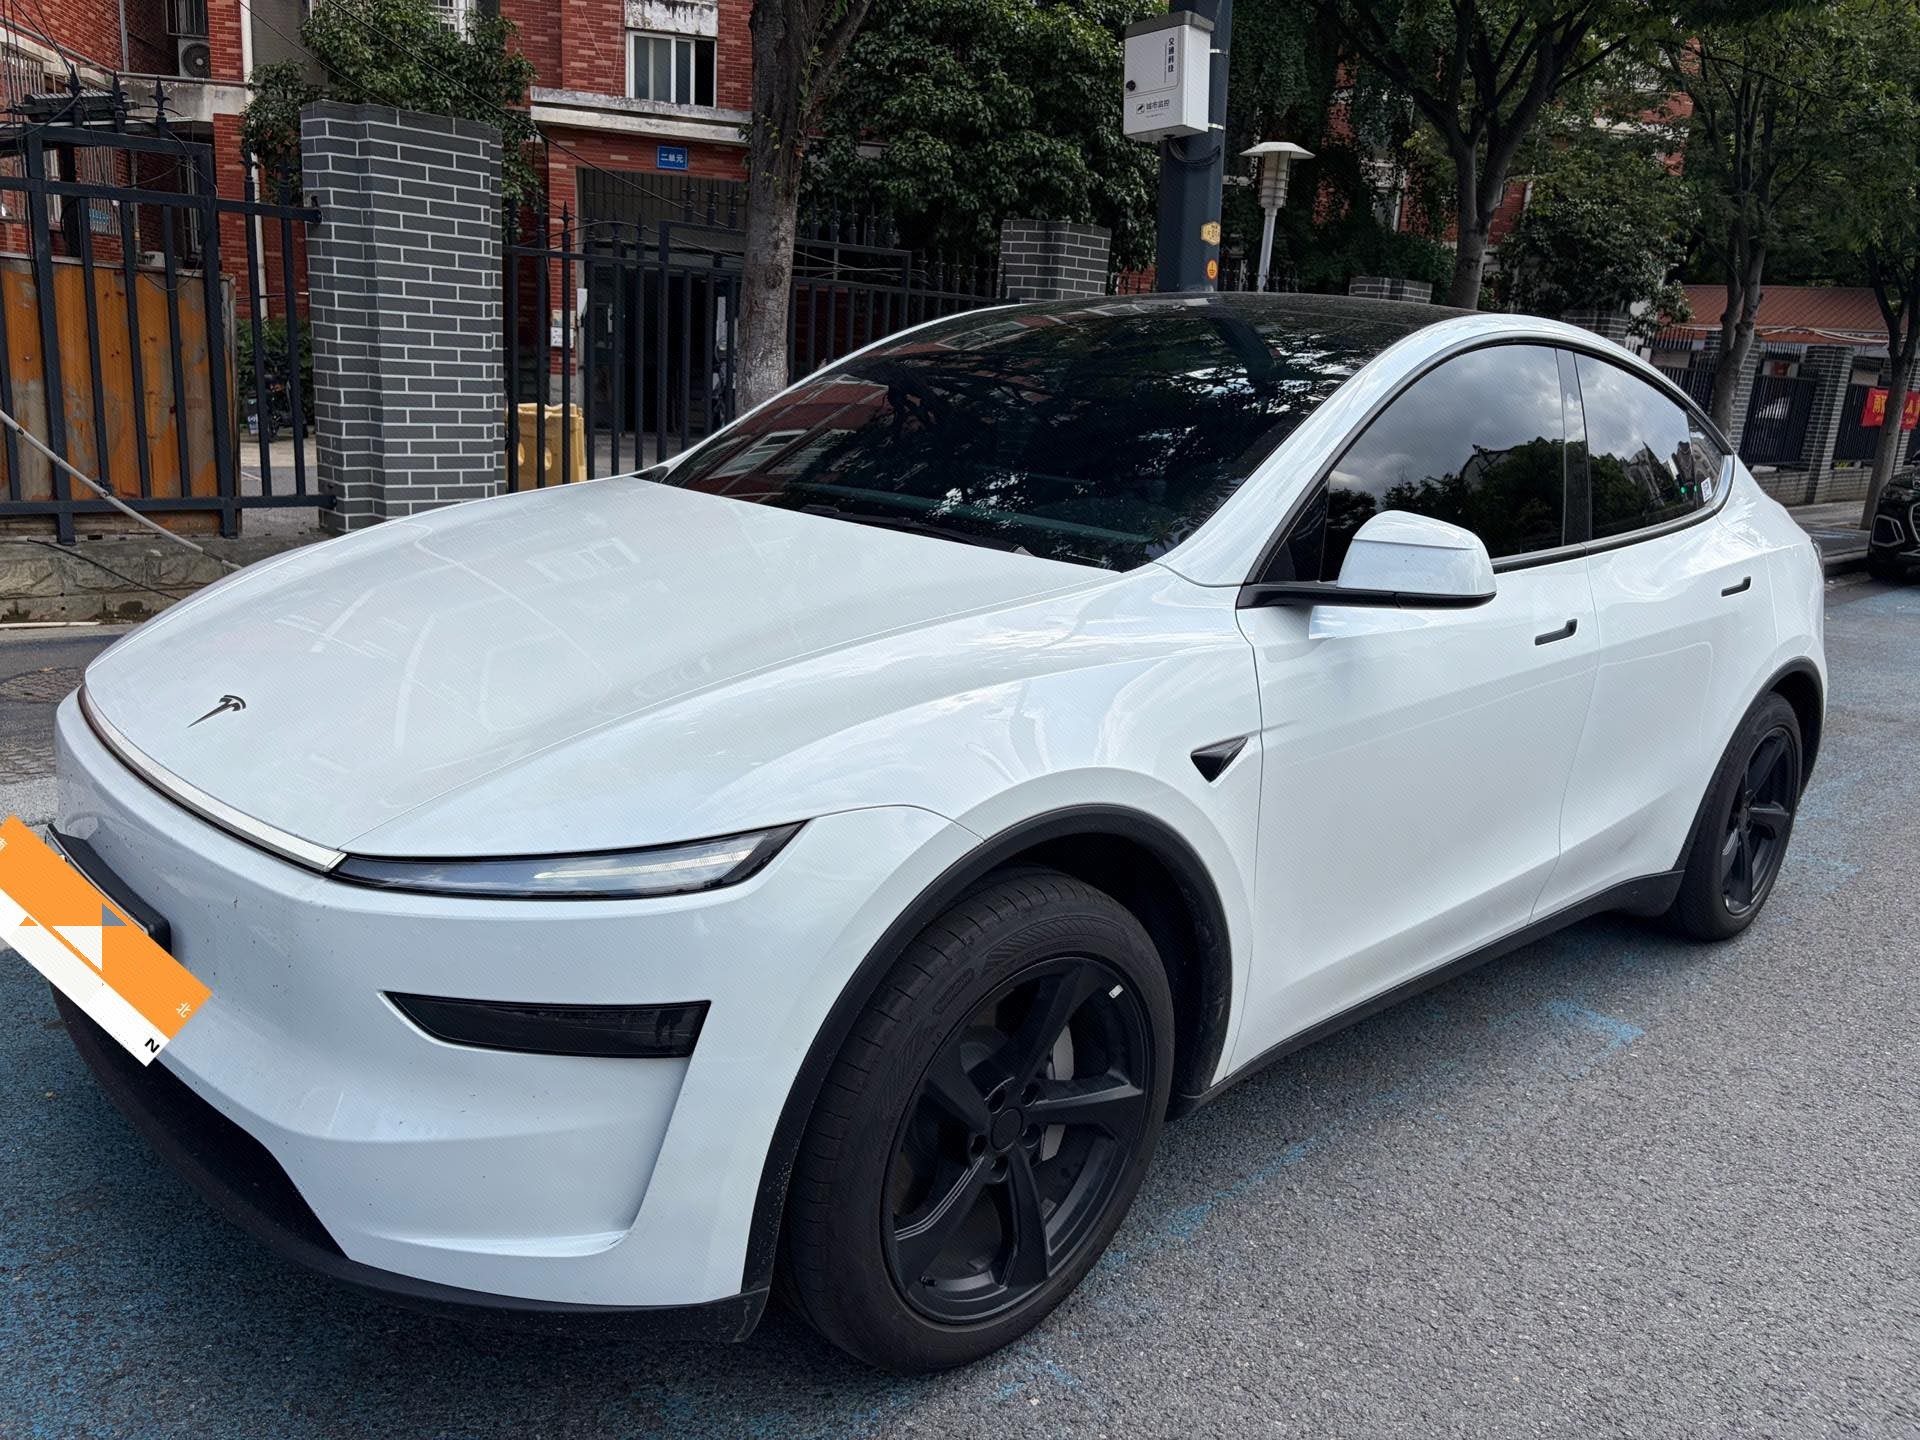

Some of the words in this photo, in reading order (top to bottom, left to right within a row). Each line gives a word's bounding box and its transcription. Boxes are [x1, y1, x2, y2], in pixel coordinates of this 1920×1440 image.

[1146, 99, 1170, 110] 城市监控
[660, 153, 684, 163] 二单元
